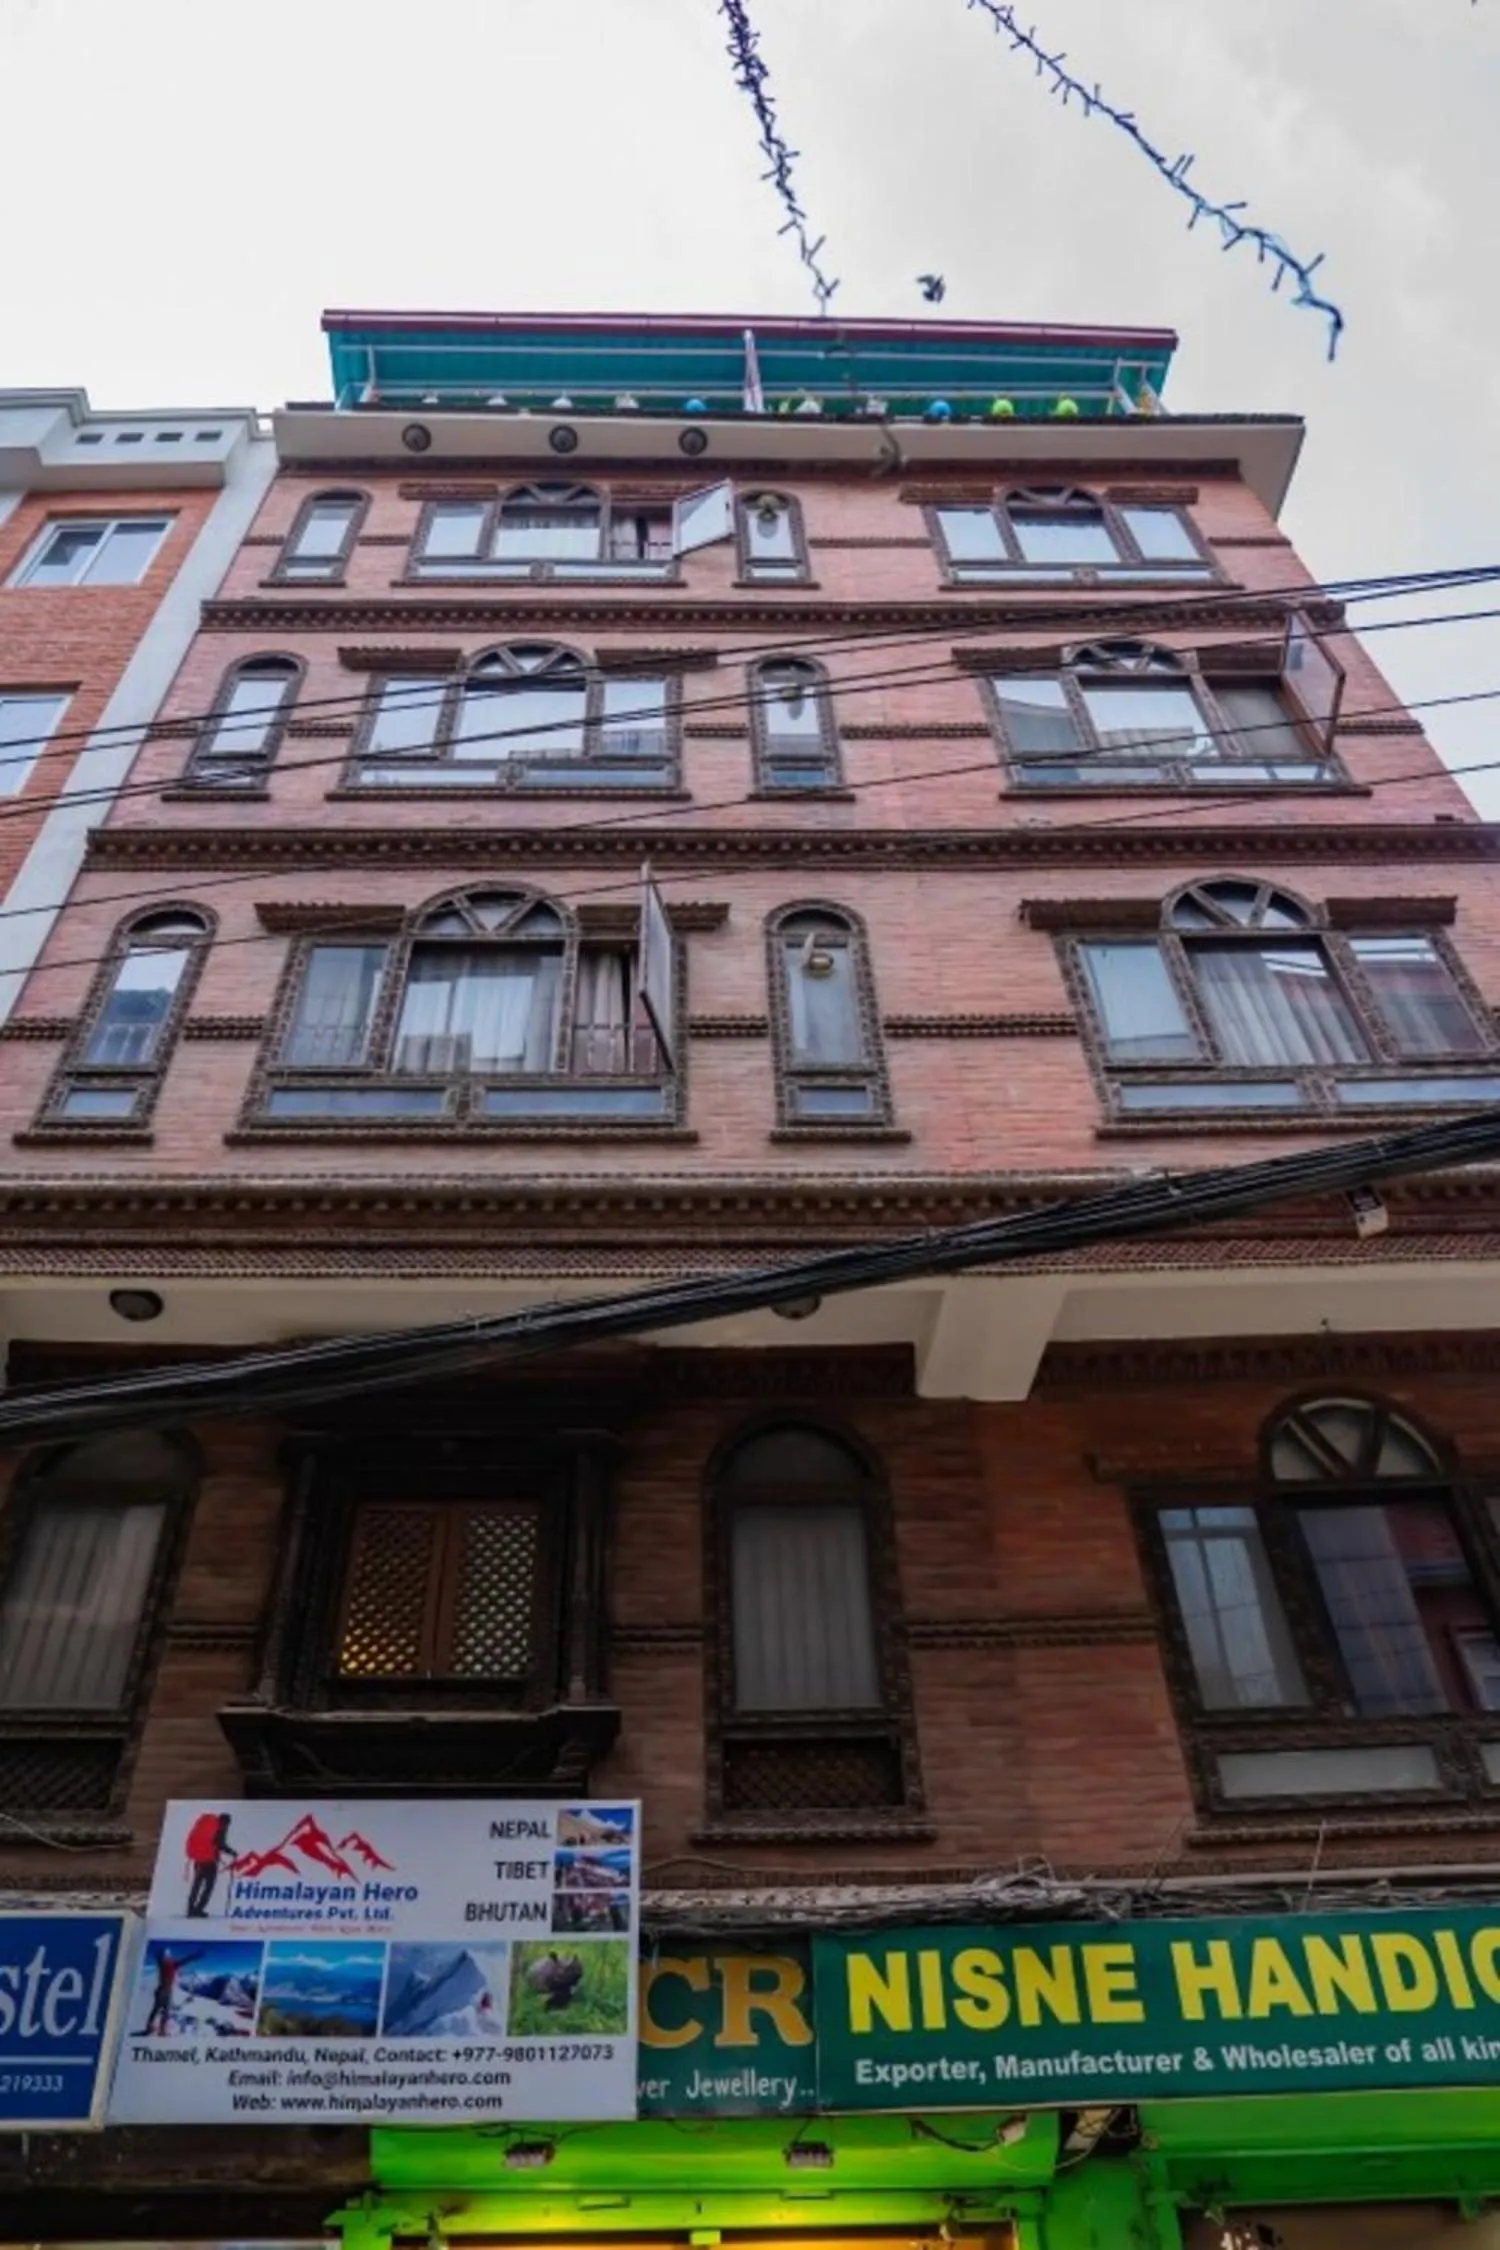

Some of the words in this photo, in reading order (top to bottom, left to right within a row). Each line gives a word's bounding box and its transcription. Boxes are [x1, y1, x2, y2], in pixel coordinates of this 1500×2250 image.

[490, 1820, 551, 1839] NEPAL
[494, 1861, 549, 1879] TIBET
[235, 1882, 356, 1904] Himalayan
[363, 1882, 418, 1901] Hero
[231, 1907, 322, 1920] Adventures
[464, 1902, 547, 1922] BHUTAN
[847, 1943, 1144, 2034] NISNE
[638, 1956, 815, 2048] CR
[205, 2047, 309, 2065] Kathmandu,
[453, 2044, 614, 2062] +977-9801127073
[855, 2057, 986, 2087] Exporter,
[995, 2050, 1182, 2080] Manufacturer
[1193, 2047, 1214, 2071] &
[1221, 2041, 1375, 2071] Wholesaler
[1385, 2038, 1411, 2063] of
[1421, 2036, 1455, 2062] all
[228, 2070, 282, 2086] Email:
[286, 2070, 511, 2090] info@himalayanhero.com
[233, 2094, 276, 2110] Web:
[280, 2093, 503, 2113] www.himalayanhero.com
